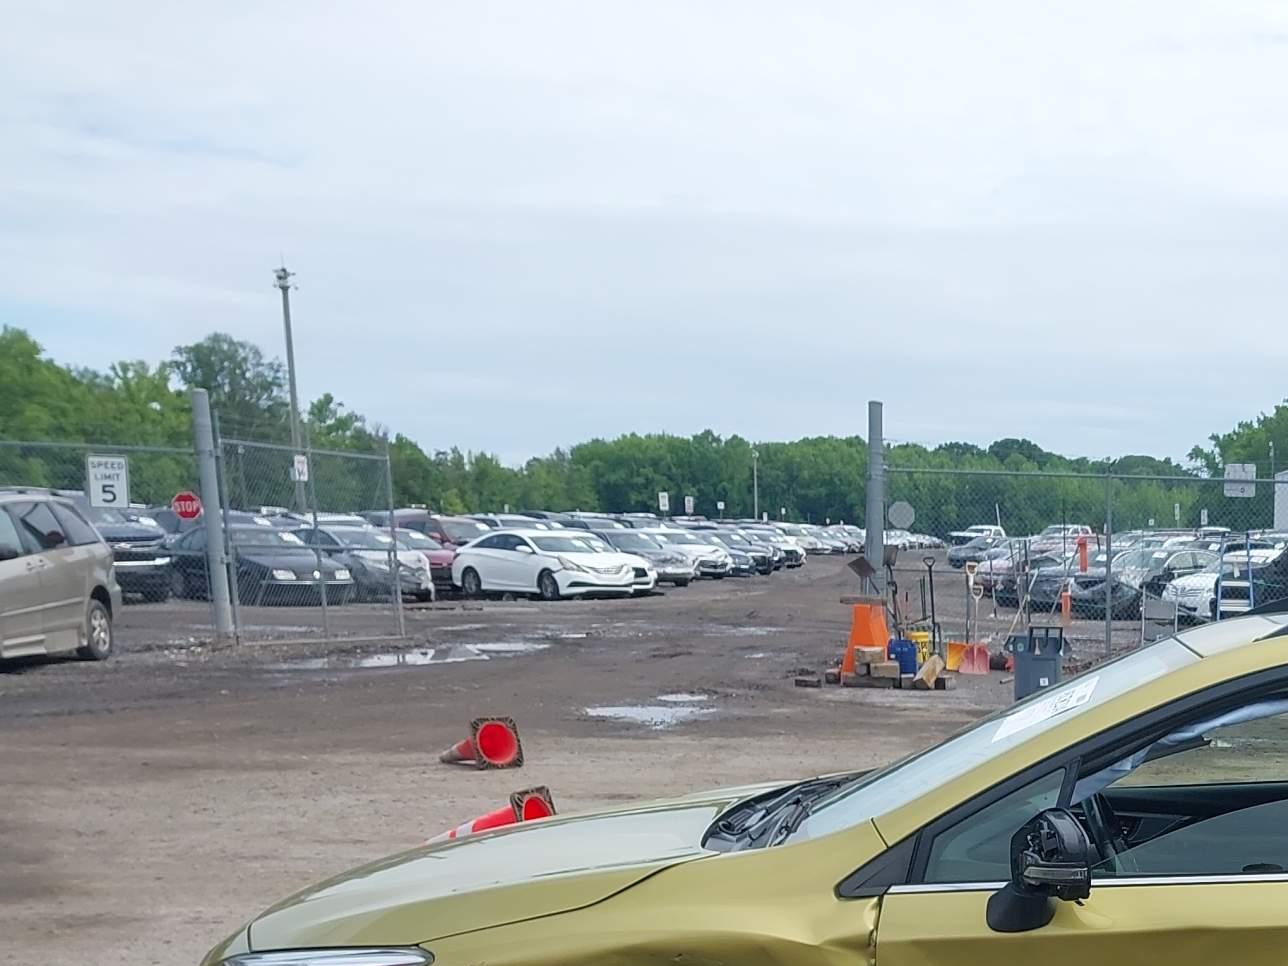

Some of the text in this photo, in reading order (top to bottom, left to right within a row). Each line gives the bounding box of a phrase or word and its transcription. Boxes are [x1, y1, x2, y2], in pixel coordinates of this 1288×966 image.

[91, 461, 124, 470] SPEED
[95, 473, 121, 481] LIMIT
[102, 485, 117, 503] 5
[174, 500, 199, 512] STOP
